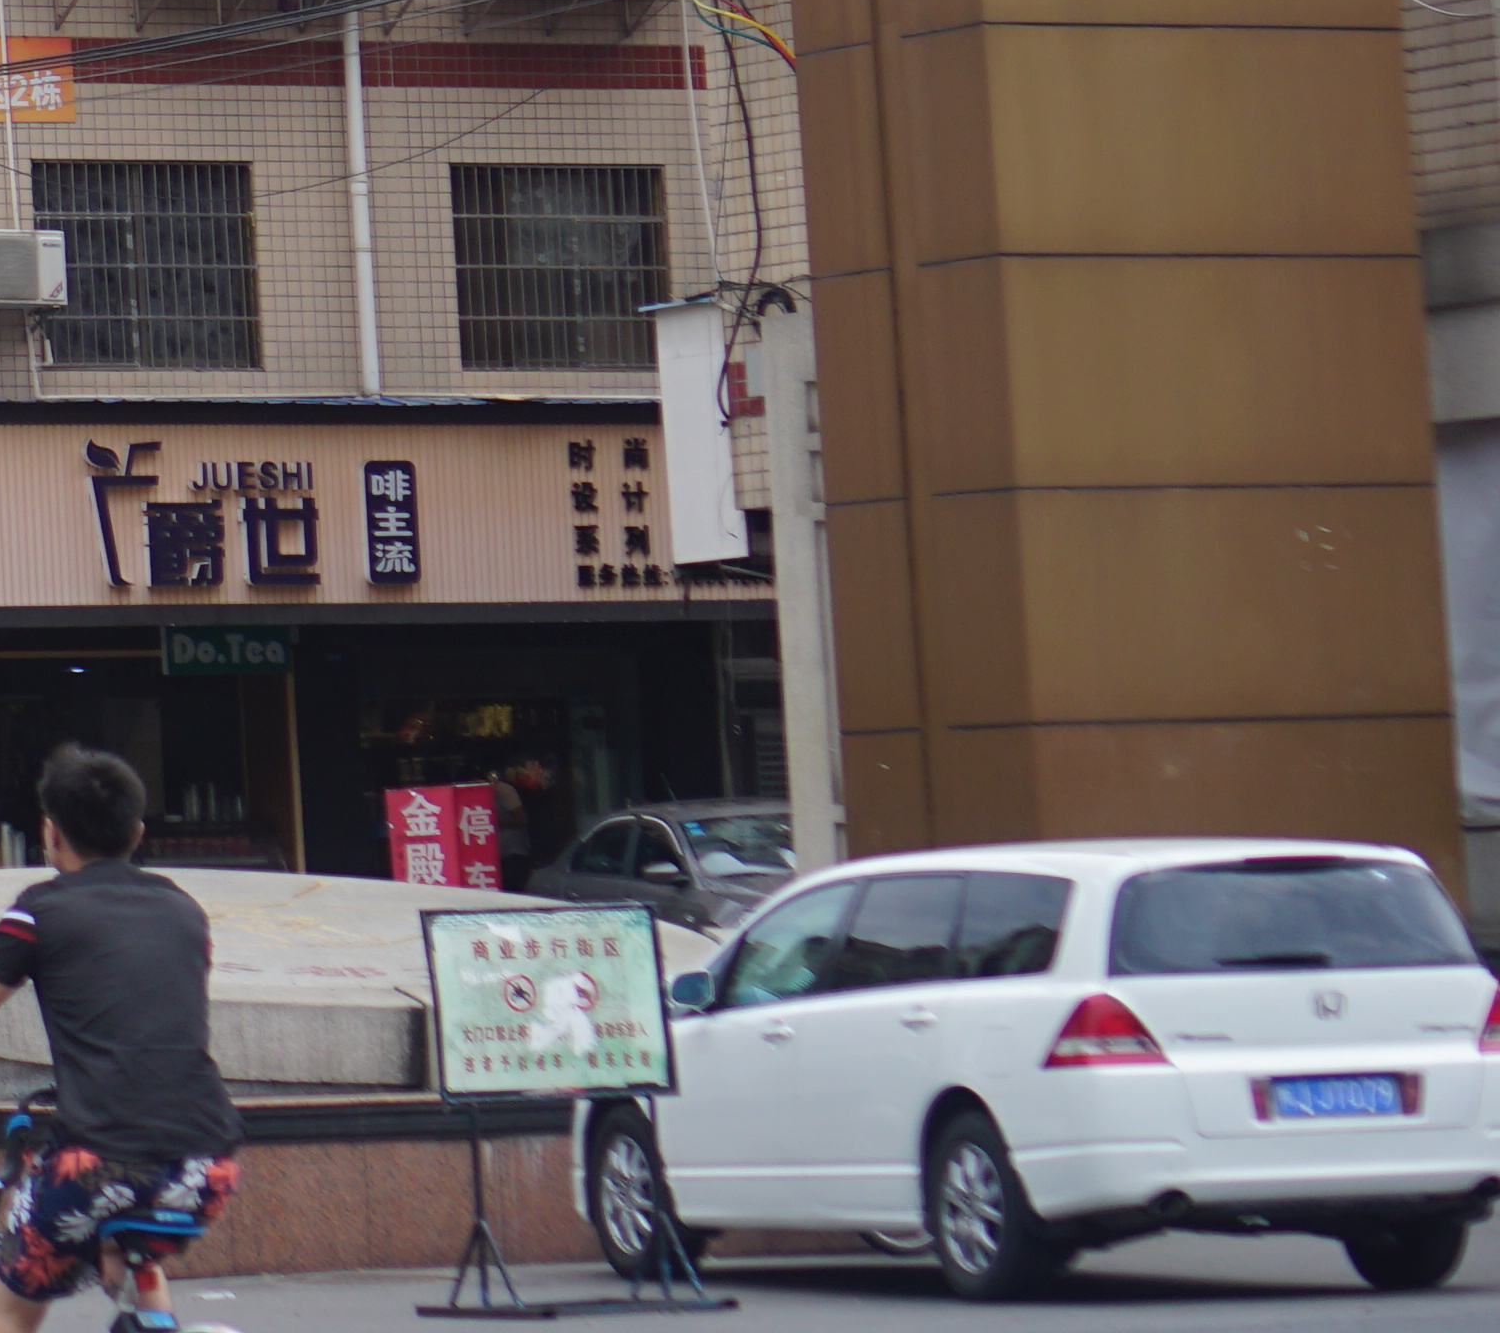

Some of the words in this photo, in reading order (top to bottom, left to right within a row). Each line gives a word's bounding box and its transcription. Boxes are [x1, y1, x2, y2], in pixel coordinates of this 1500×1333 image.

[188, 461, 314, 491] JUESHI
[371, 469, 416, 573] 啡主流
[173, 634, 286, 665] Do.Tea
[401, 791, 447, 885] 金殿
[471, 935, 621, 962] 商业步行街区
